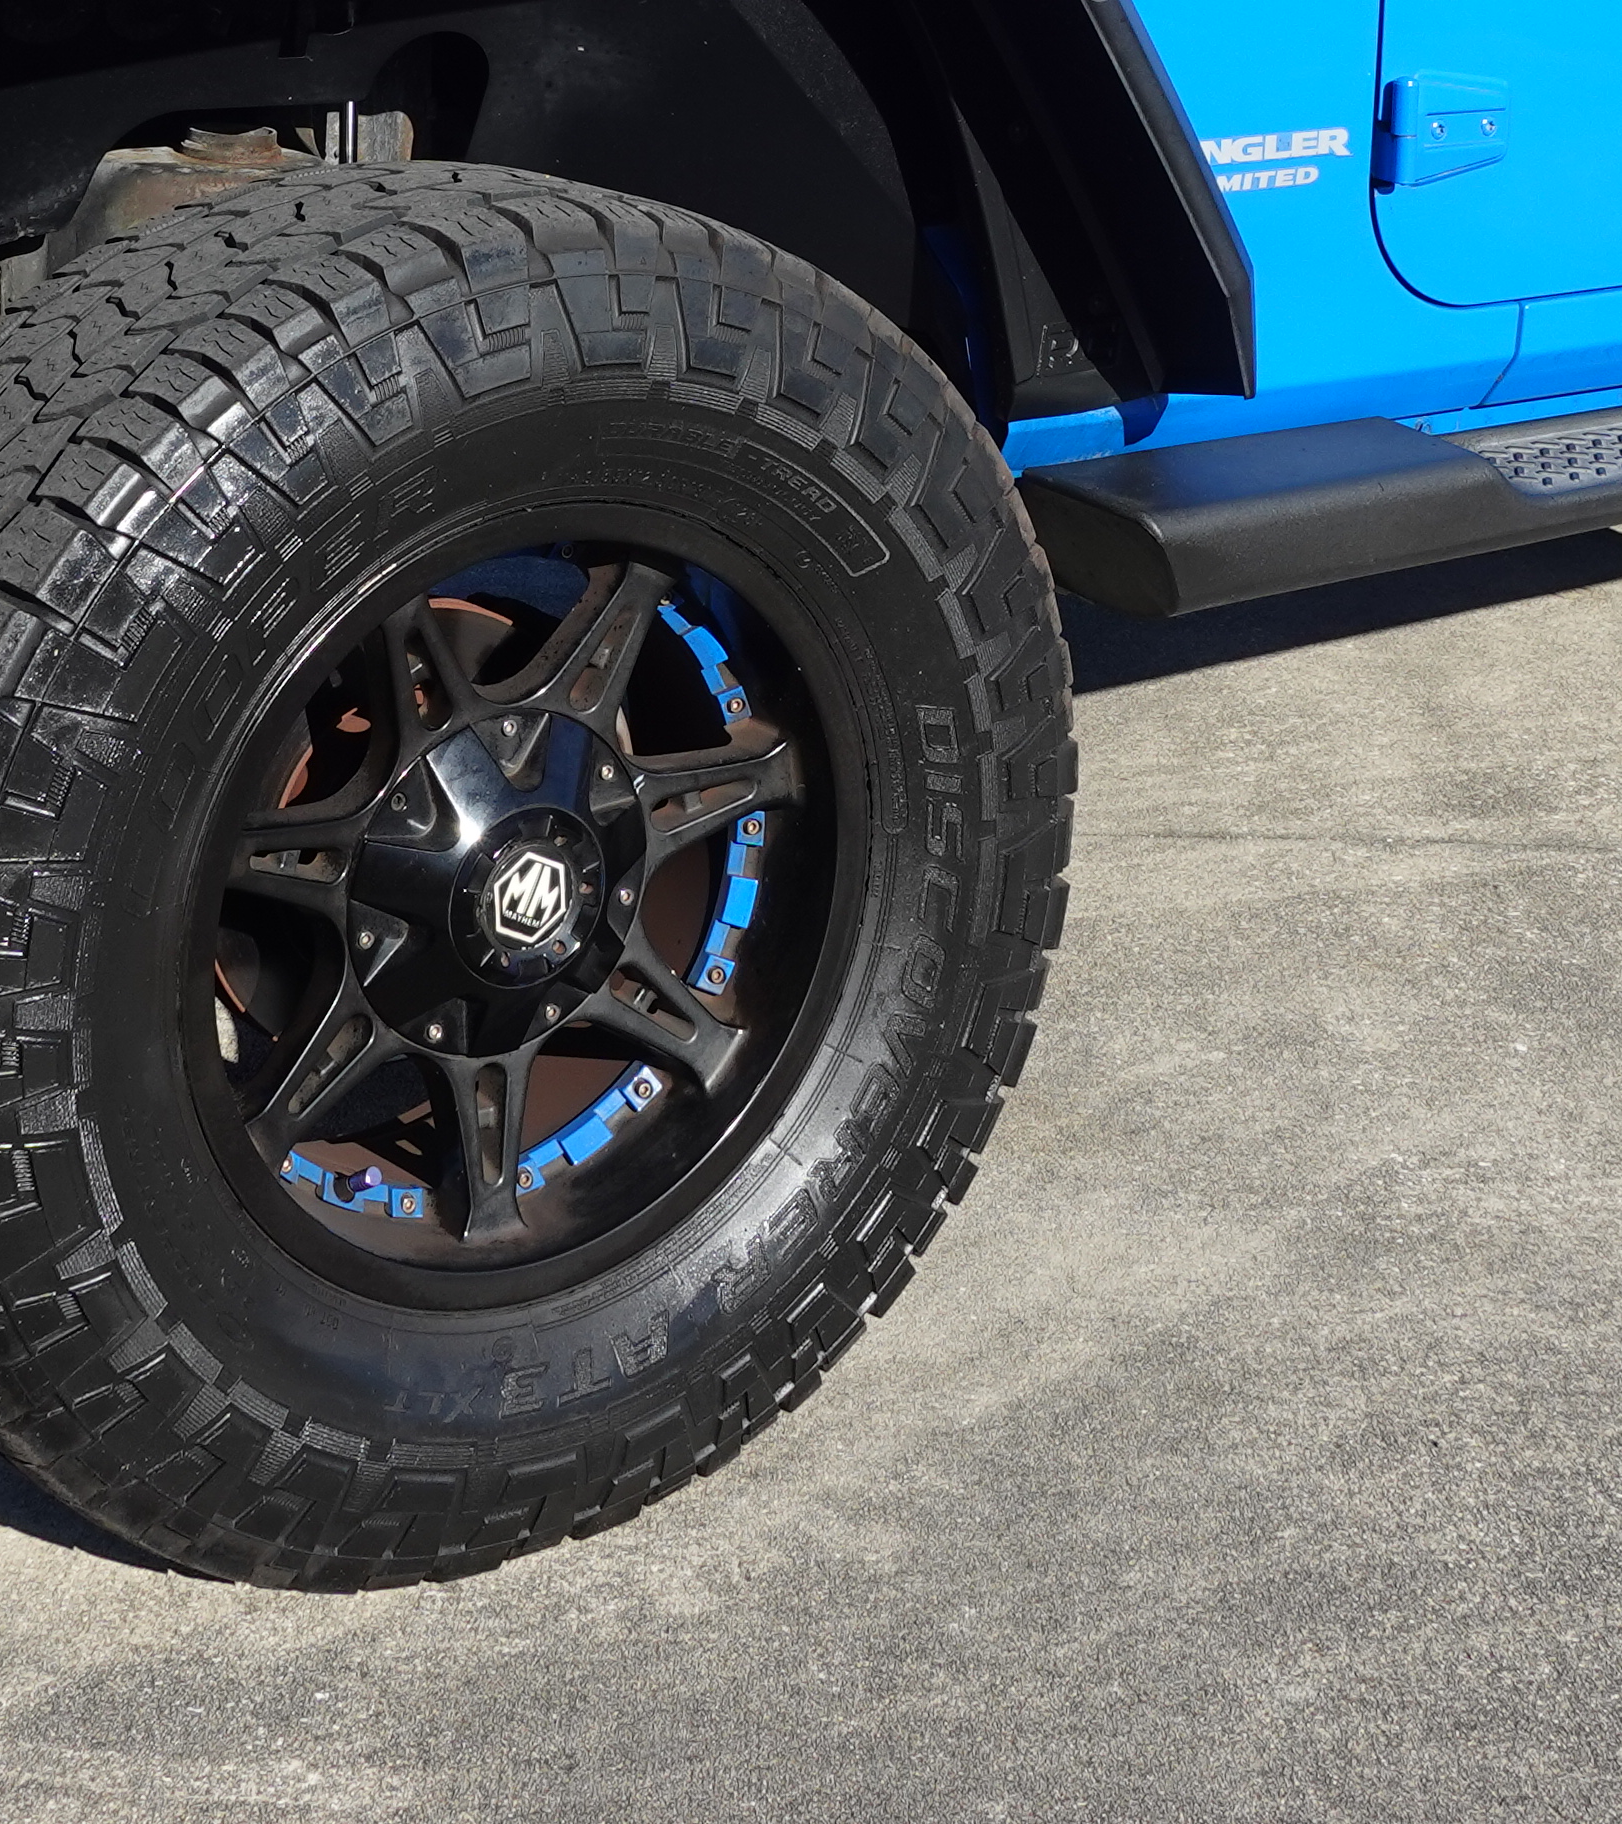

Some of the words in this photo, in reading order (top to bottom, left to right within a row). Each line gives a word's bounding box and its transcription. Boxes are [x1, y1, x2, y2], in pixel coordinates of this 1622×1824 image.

[1199, 127, 1353, 164] NGLER
[1217, 166, 1319, 191] MITED
[504, 909, 541, 928] MAYHEM
[715, 703, 969, 1315] DISCOVERER
[498, 1308, 671, 1419] AT3
